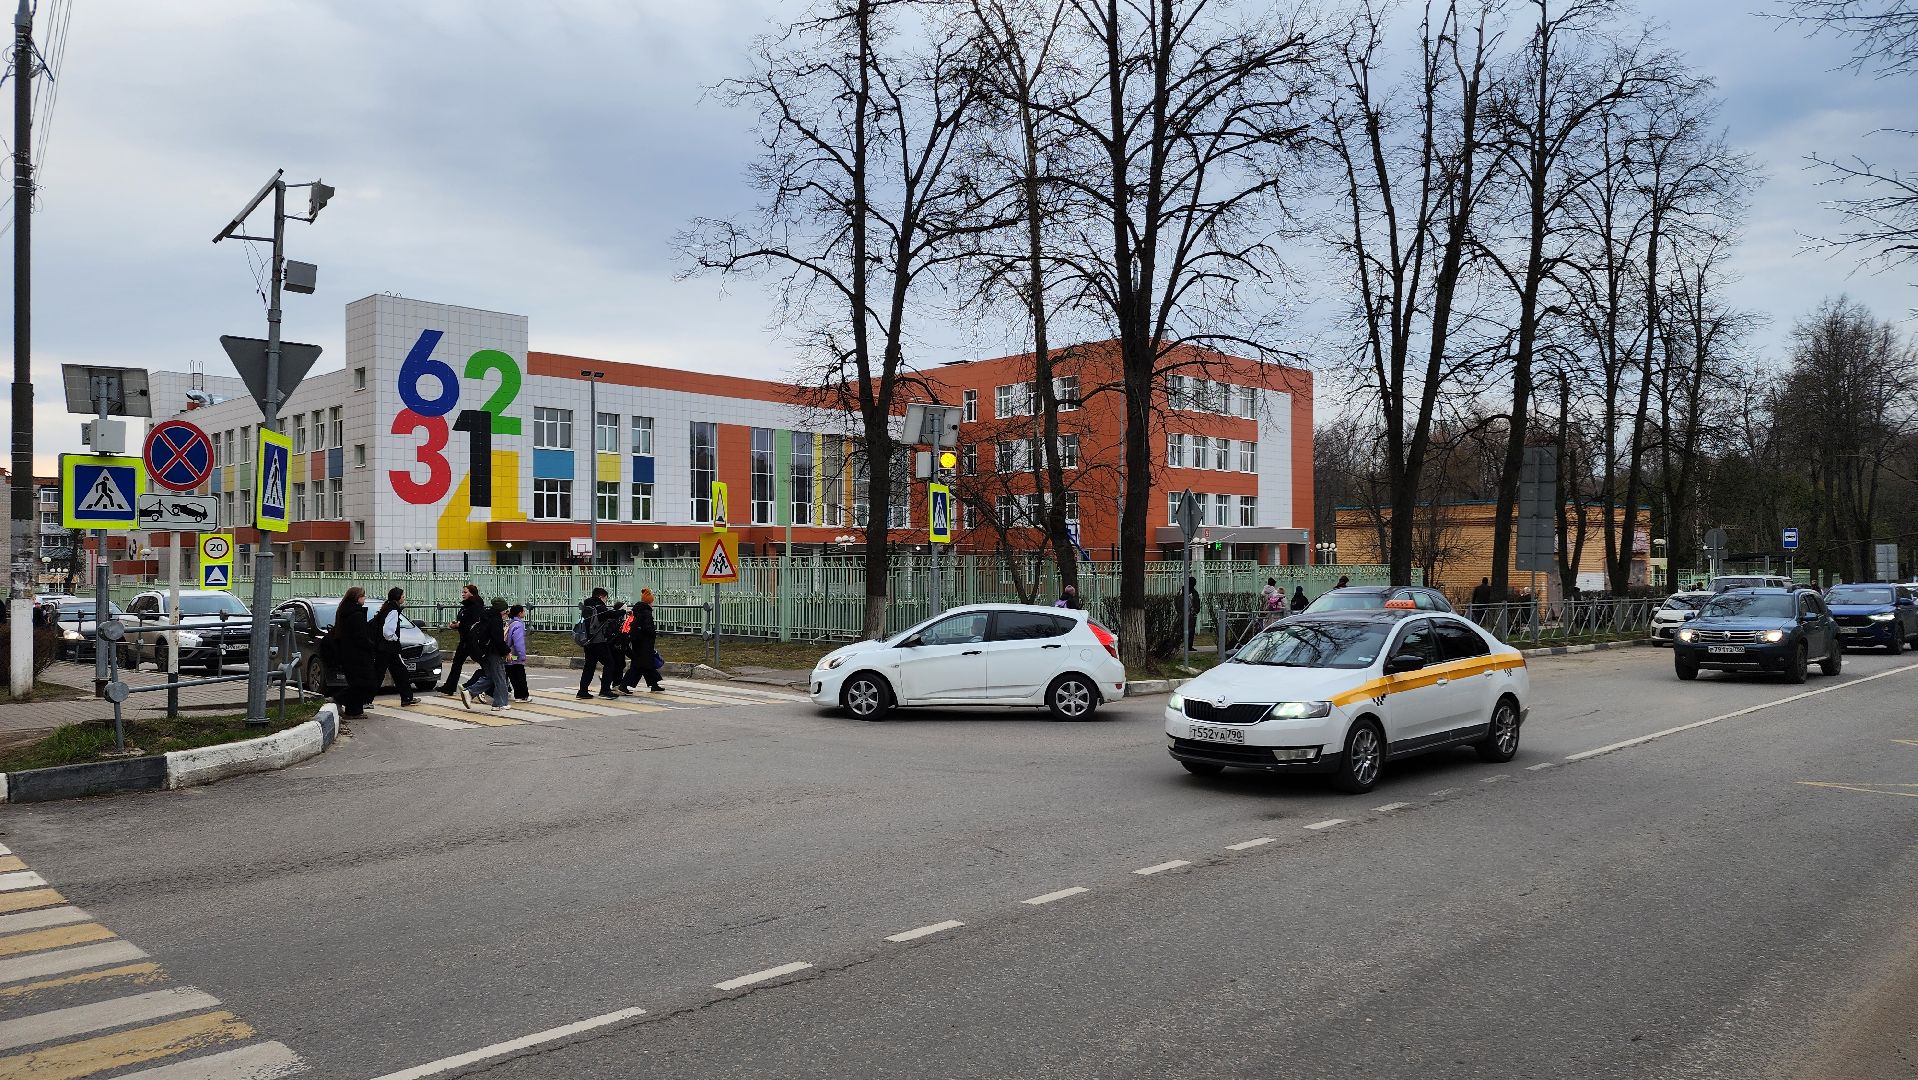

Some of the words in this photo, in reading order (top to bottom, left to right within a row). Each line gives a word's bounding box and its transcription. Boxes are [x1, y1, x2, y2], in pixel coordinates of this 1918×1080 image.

[398, 329, 460, 417] 6
[464, 349, 522, 435] 2
[389, 407, 452, 505] 3
[452, 409, 492, 507] 1
[209, 543, 223, 552] 20
